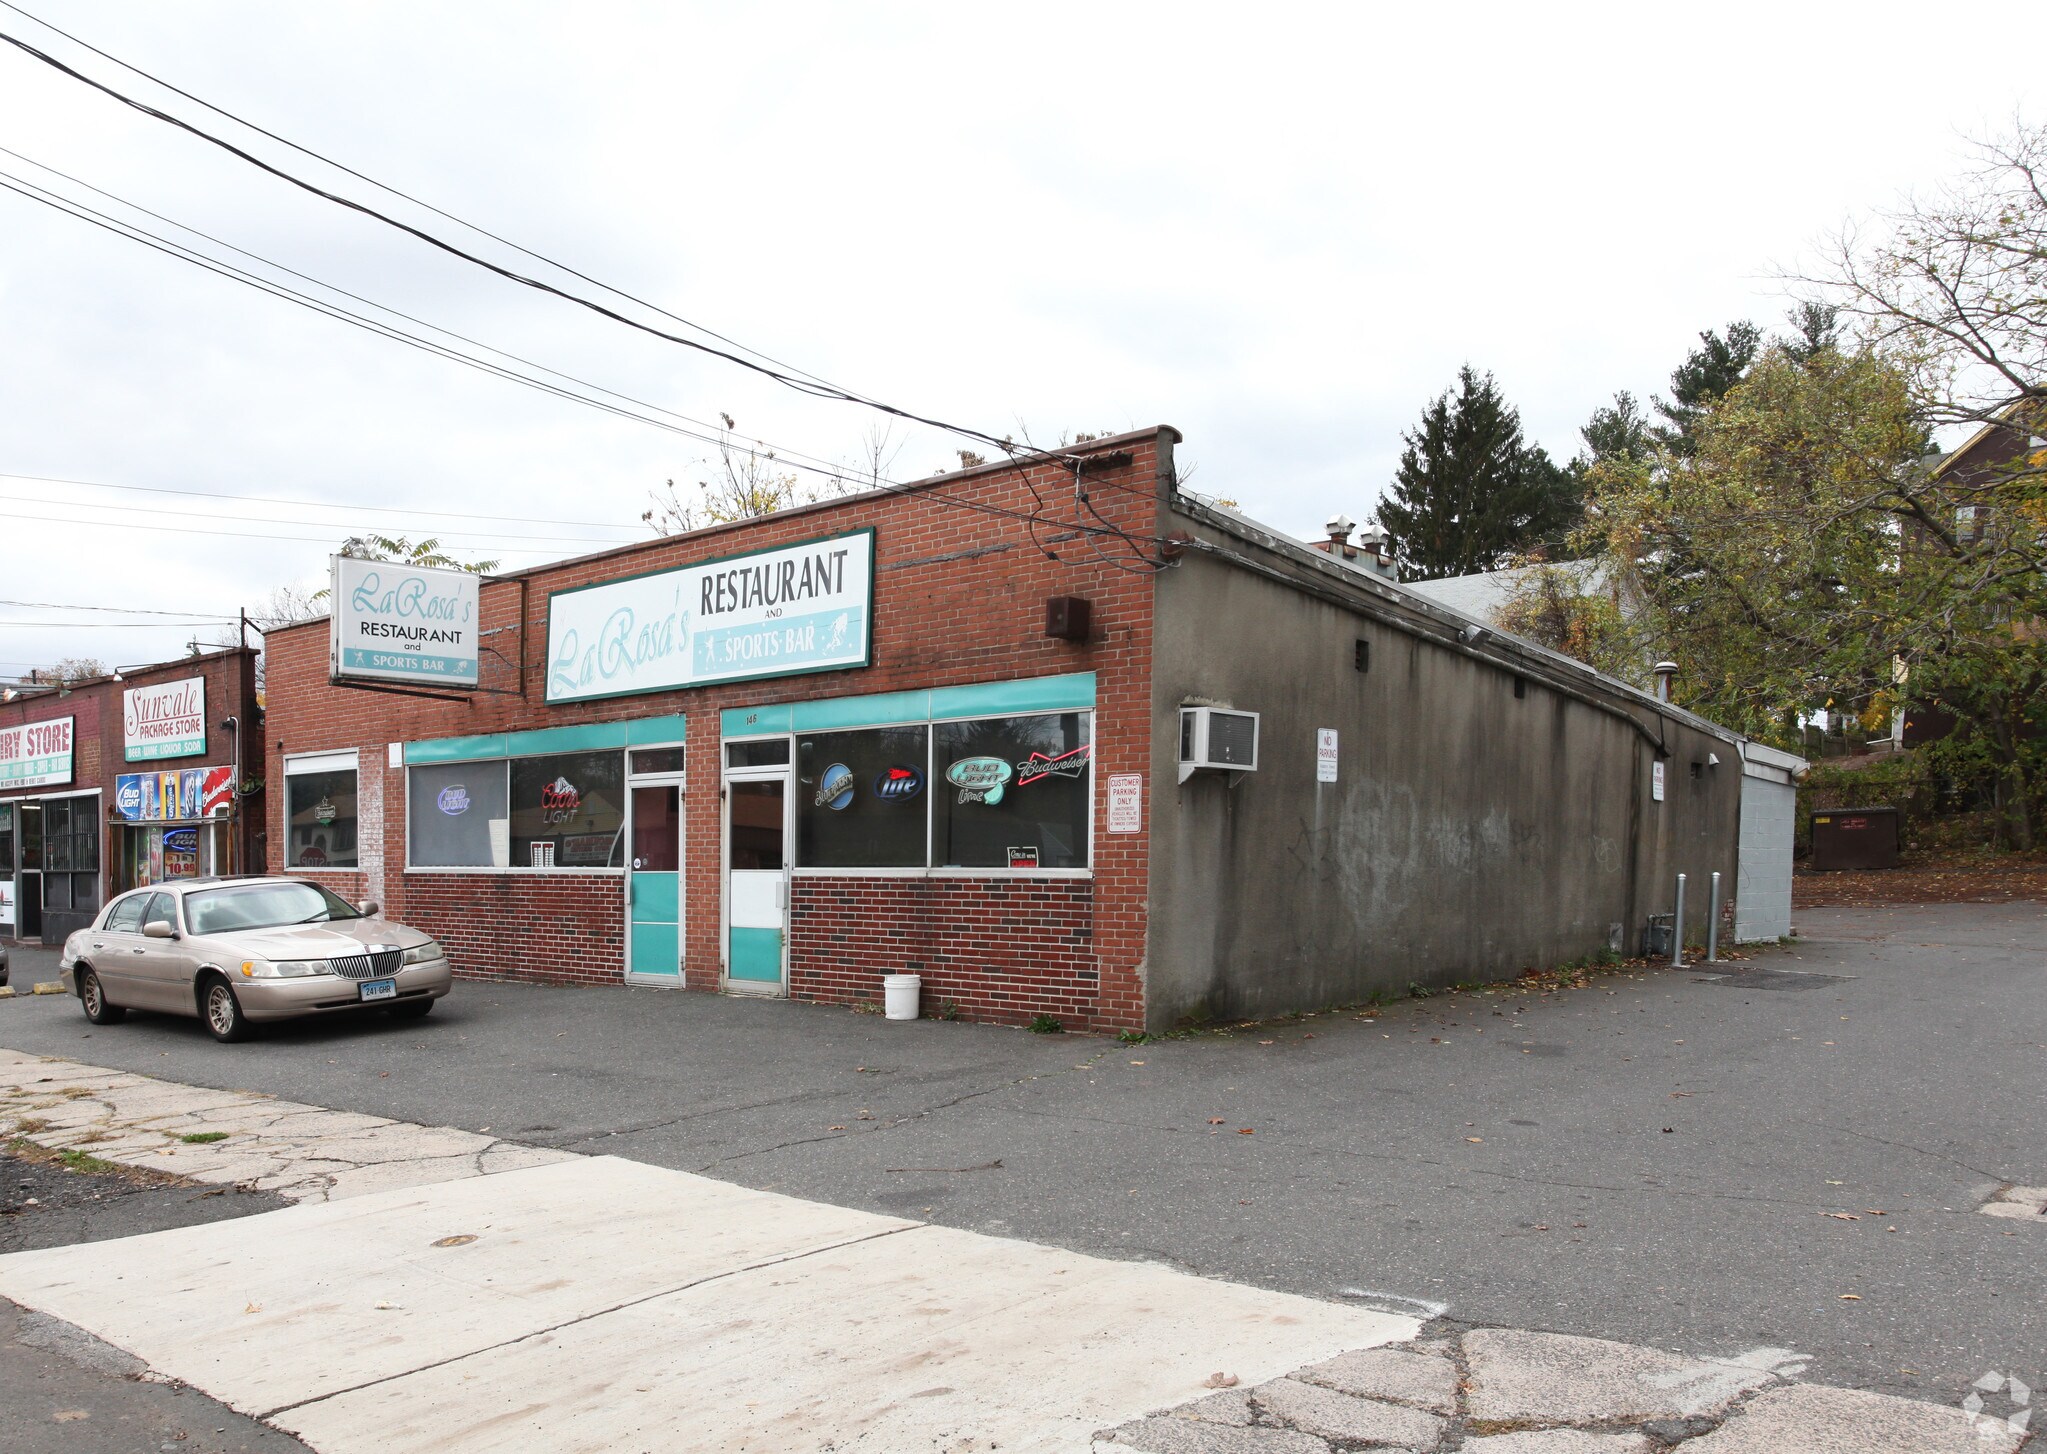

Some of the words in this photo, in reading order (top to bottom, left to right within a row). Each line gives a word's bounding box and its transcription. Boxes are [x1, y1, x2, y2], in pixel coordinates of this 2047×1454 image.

[700, 549, 849, 617] RESTAURANT
[764, 607, 783, 619] AND
[360, 621, 462, 644] RESTAURANT
[404, 642, 421, 651] and
[725, 631, 780, 663] SPORTS
[785, 625, 815, 653] BAR
[373, 655, 418, 669] SPORTS
[422, 659, 445, 671] BAR
[126, 683, 197, 737] Sunvale
[140, 722, 174, 740] PACKAGE
[175, 718, 201, 736] STORE
[27, 722, 70, 757] STORE
[1323, 736, 1332, 746] NO
[128, 746, 142, 759] BEER
[160, 742, 182, 755] LIQUOR
[184, 740, 201, 753] SODA
[1319, 748, 1337, 759] PARKING
[963, 763, 999, 773] BUD
[1016, 756, 1090, 777] Budweiser
[956, 773, 1004, 784] LIGHT
[1110, 779, 1139, 787] CUSTOMER
[123, 789, 140, 798] BUD
[444, 788, 467, 799] BUD
[880, 779, 918, 798] Lite
[1112, 788, 1137, 796] PARKING
[542, 783, 580, 809] Coors
[958, 788, 984, 804] Lime
[1117, 797, 1132, 805] ONLY
[120, 798, 140, 808] LIGHT
[441, 798, 471, 811] LIGHT
[543, 809, 578, 823] LIGHT
